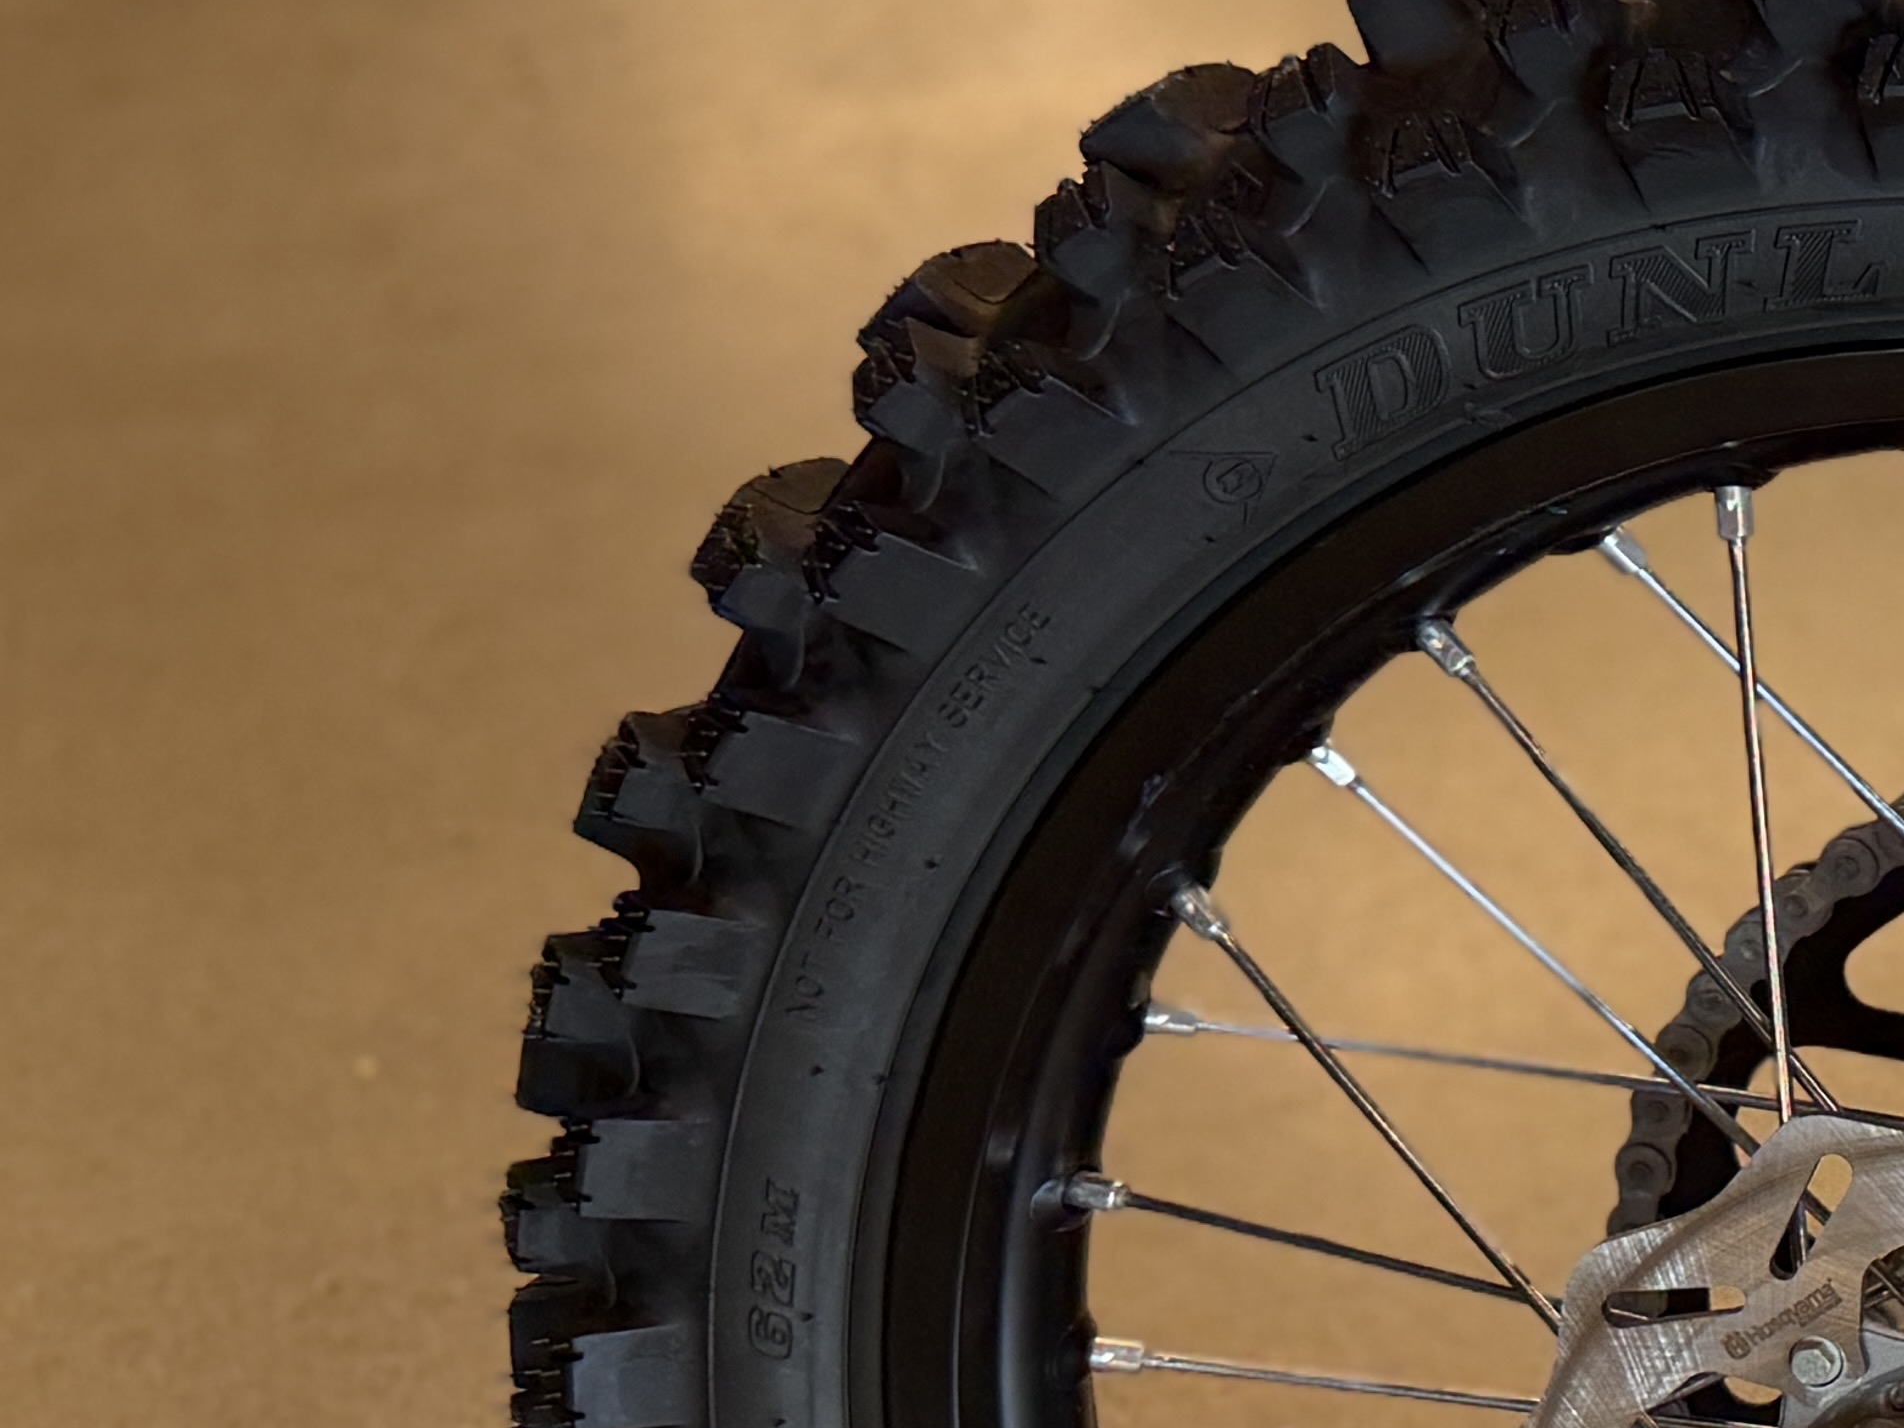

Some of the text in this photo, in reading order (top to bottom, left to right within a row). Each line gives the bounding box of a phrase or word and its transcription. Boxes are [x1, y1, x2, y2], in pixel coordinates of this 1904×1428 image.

[812, 866, 864, 941] FOR
[848, 726, 950, 871] HIGHWAY
[938, 600, 1056, 730] SERVICE
